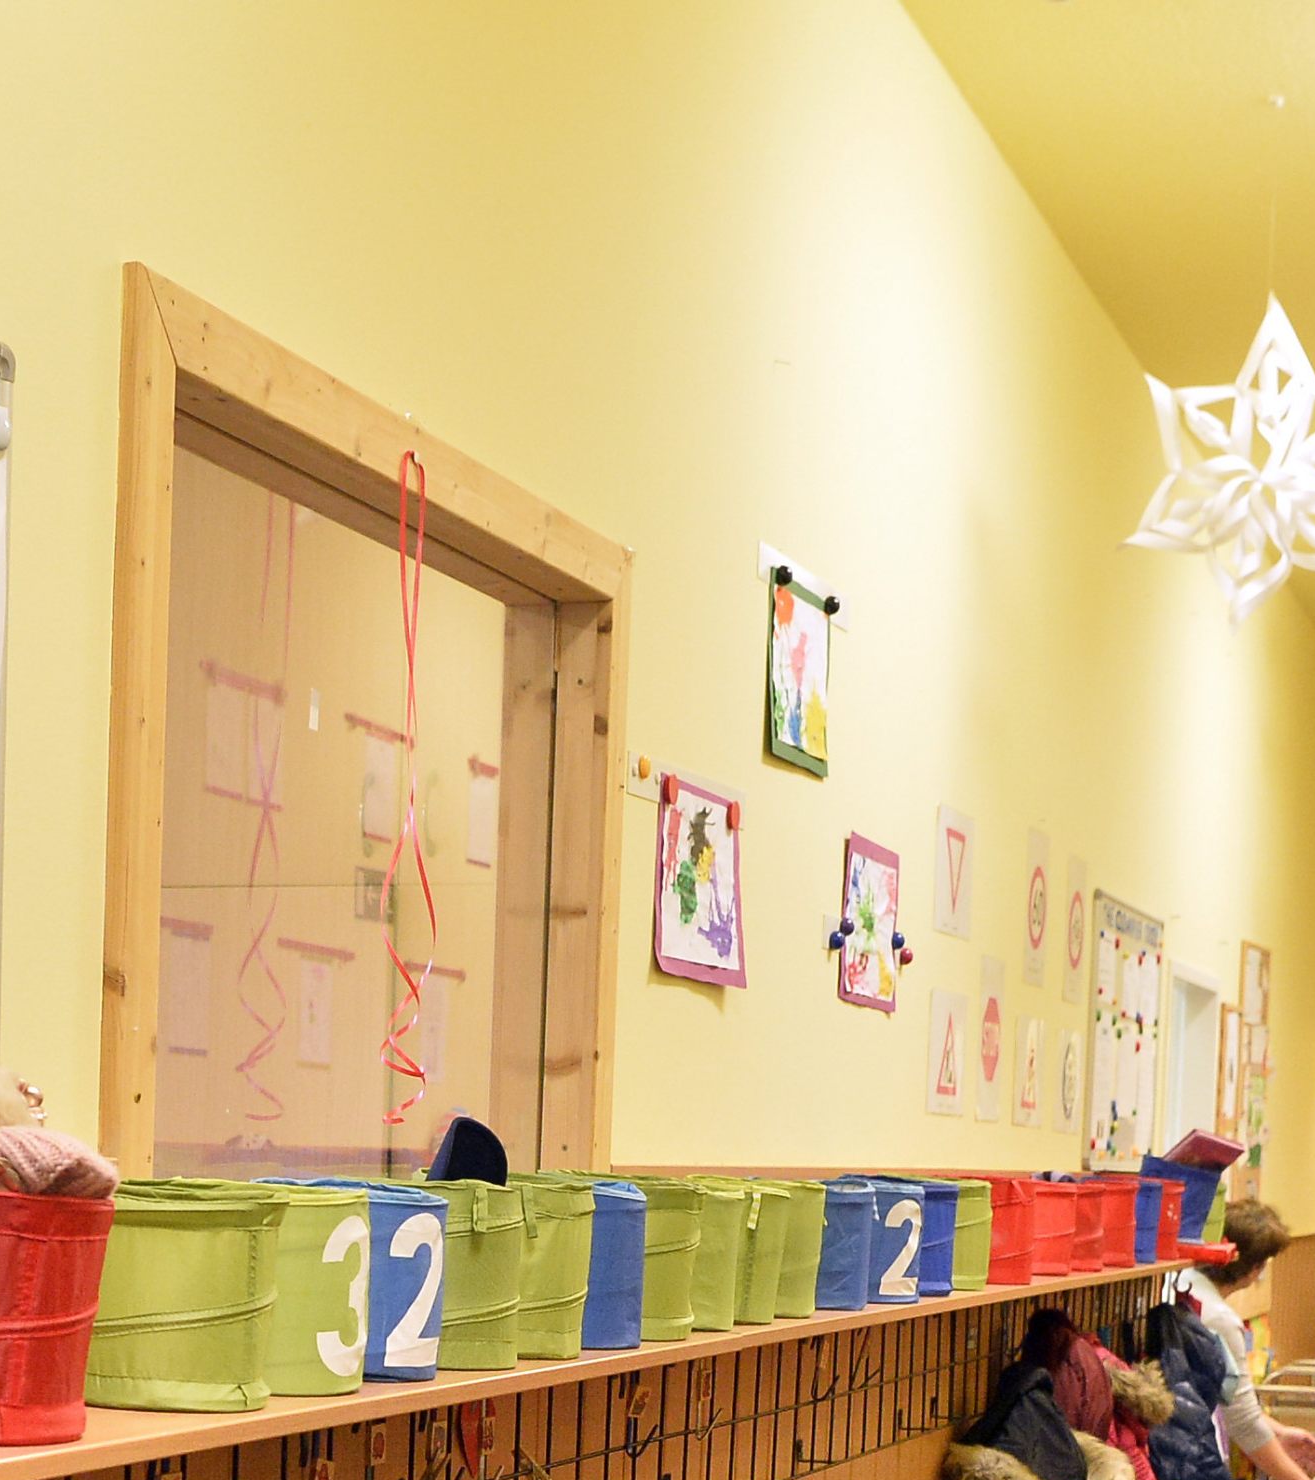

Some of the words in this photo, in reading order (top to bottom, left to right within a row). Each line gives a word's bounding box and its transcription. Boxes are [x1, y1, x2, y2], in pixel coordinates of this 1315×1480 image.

[316, 1215, 370, 1377] 3
[383, 1212, 444, 1368] 2
[878, 1199, 923, 1296] 2
